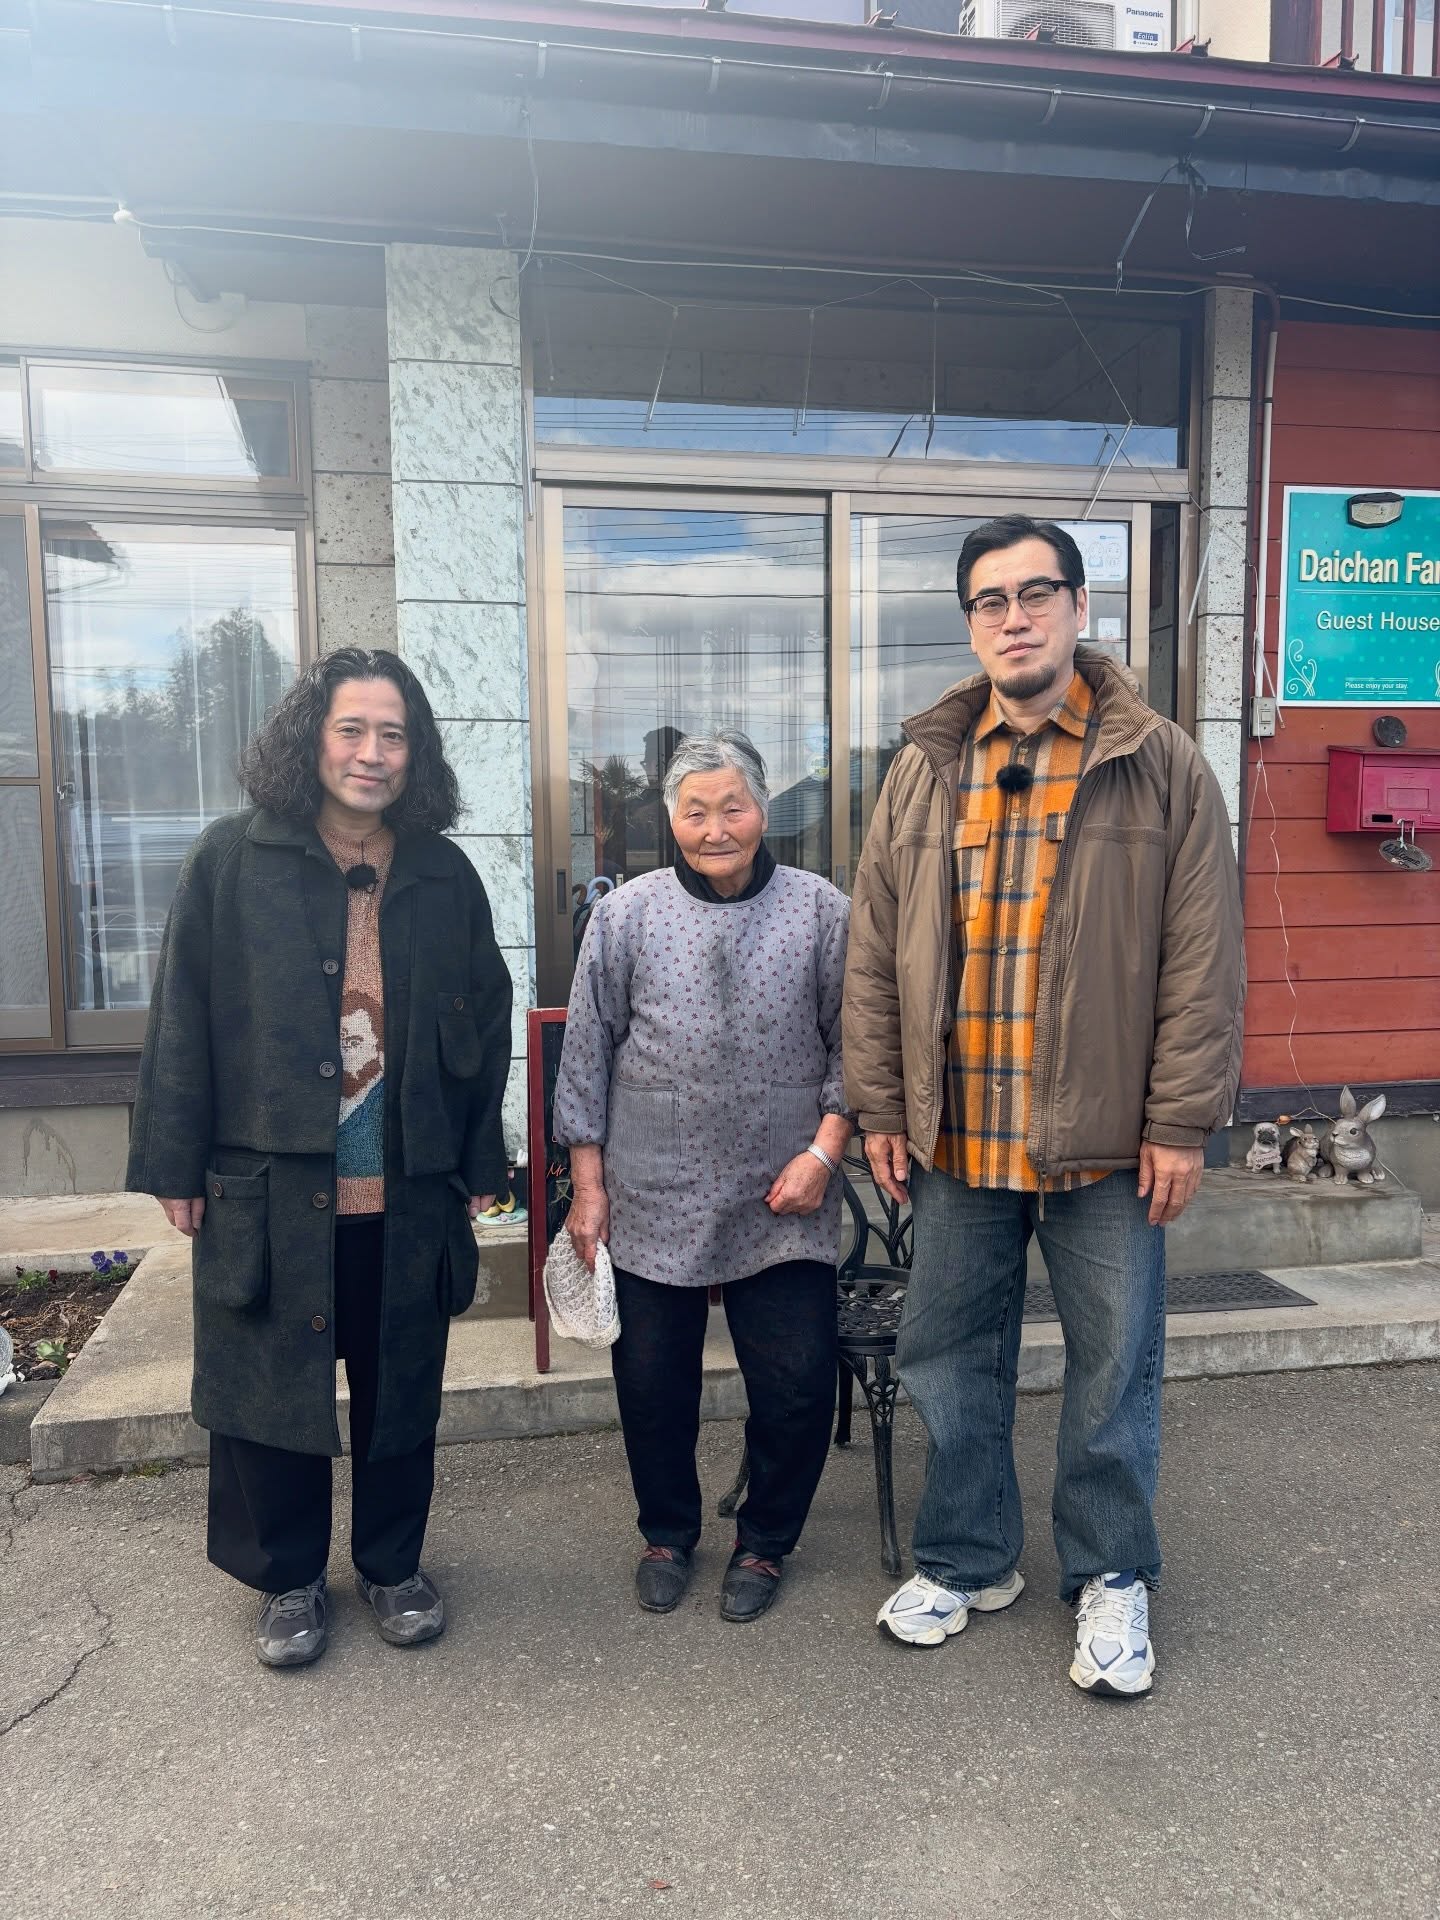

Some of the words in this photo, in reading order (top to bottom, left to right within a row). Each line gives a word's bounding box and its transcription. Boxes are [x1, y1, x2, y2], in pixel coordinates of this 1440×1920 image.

[1126, 7, 1164, 18] Panasonic
[1300, 548, 1399, 584] Daichan
[1317, 610, 1374, 630] Guest
[1381, 611, 1440, 631] House
[1345, 681, 1364, 689] Please
[1365, 682, 1381, 691] enjoy
[1382, 683, 1394, 691] your
